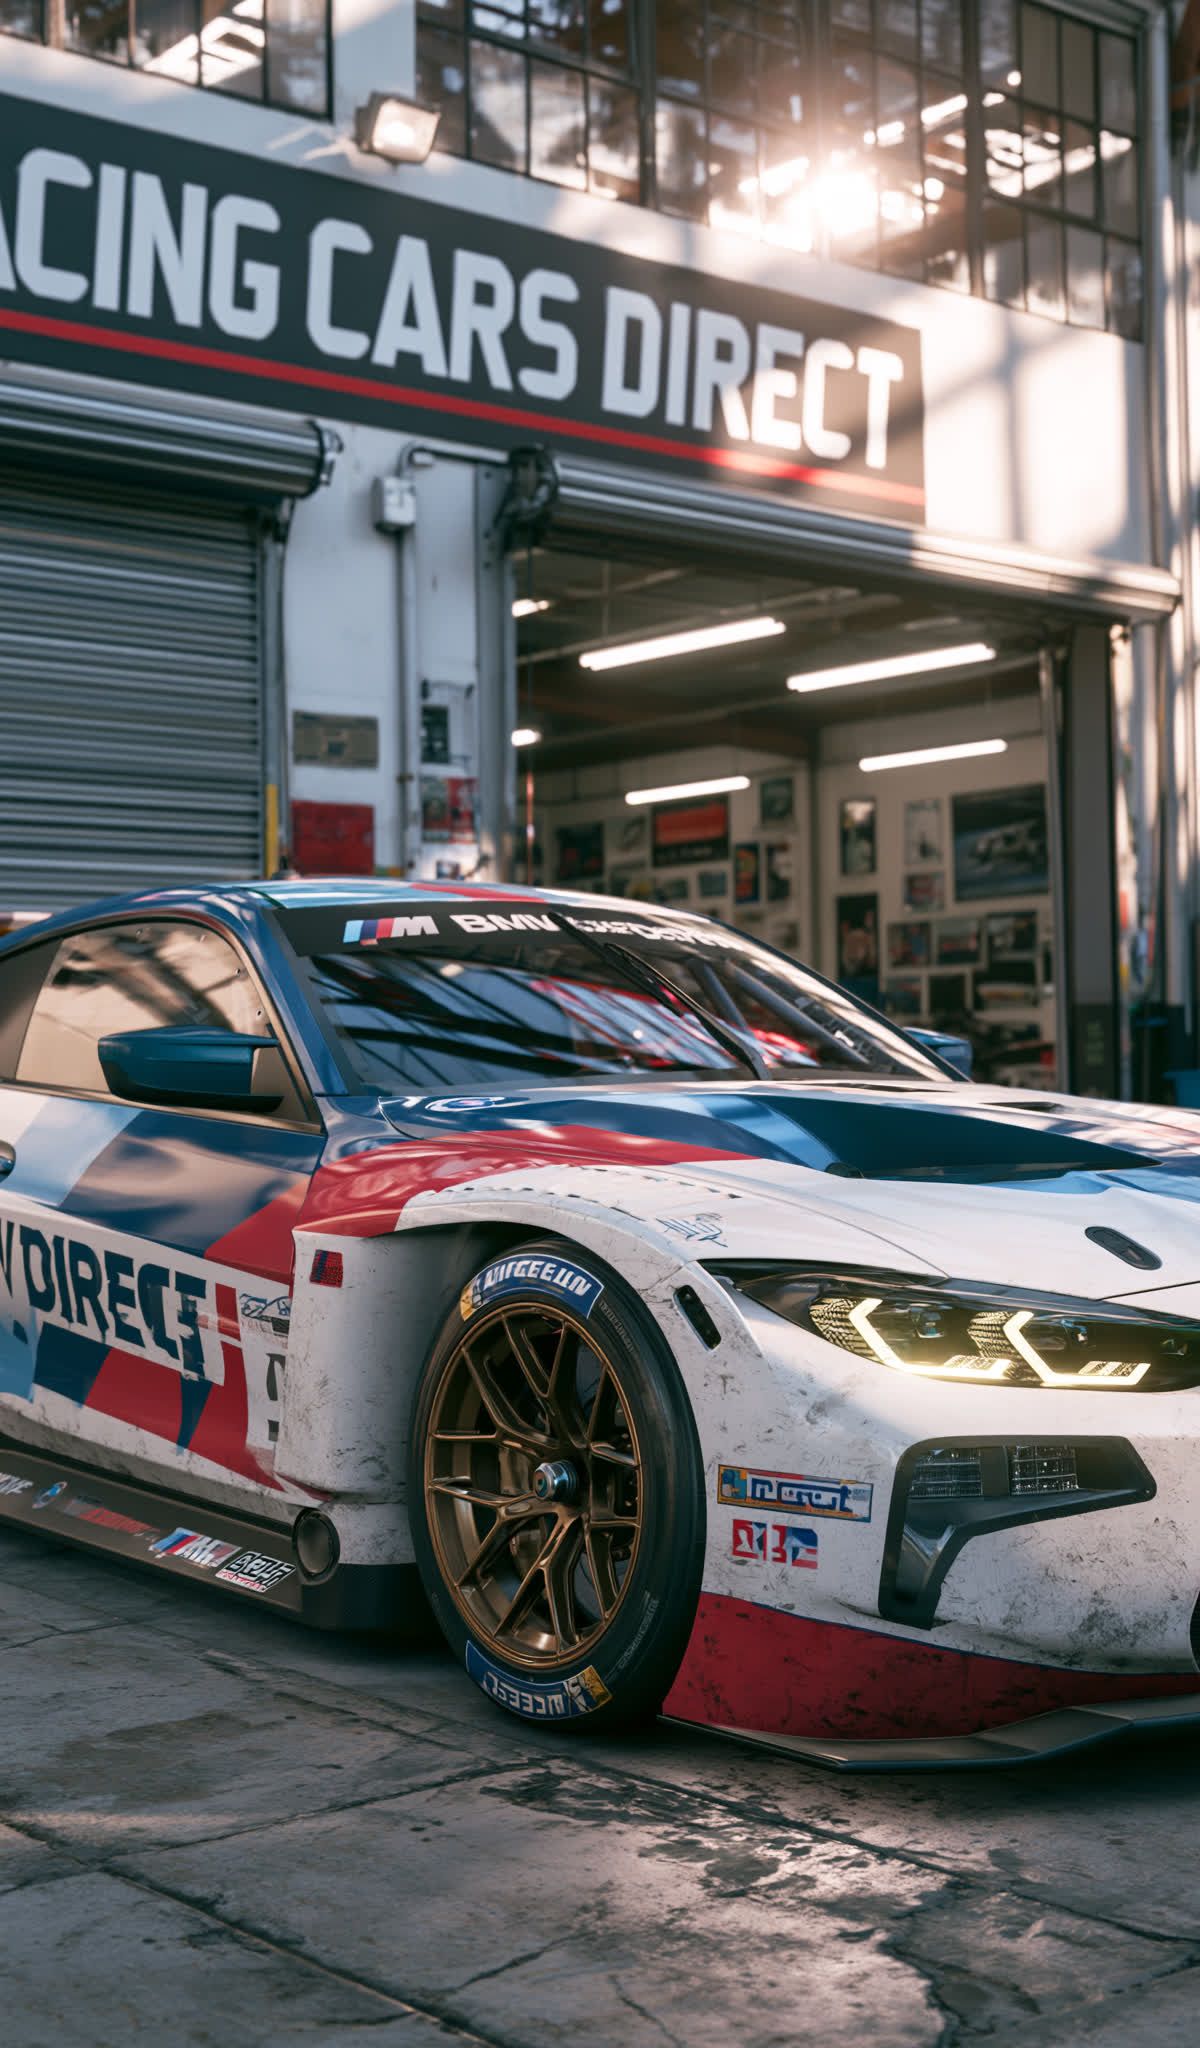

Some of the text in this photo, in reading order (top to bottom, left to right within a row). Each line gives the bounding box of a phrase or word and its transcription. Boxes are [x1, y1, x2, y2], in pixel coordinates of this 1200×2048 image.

[0, 147, 904, 469] CING CARS DIRECT
[20, 1224, 207, 1379] DIRECT
